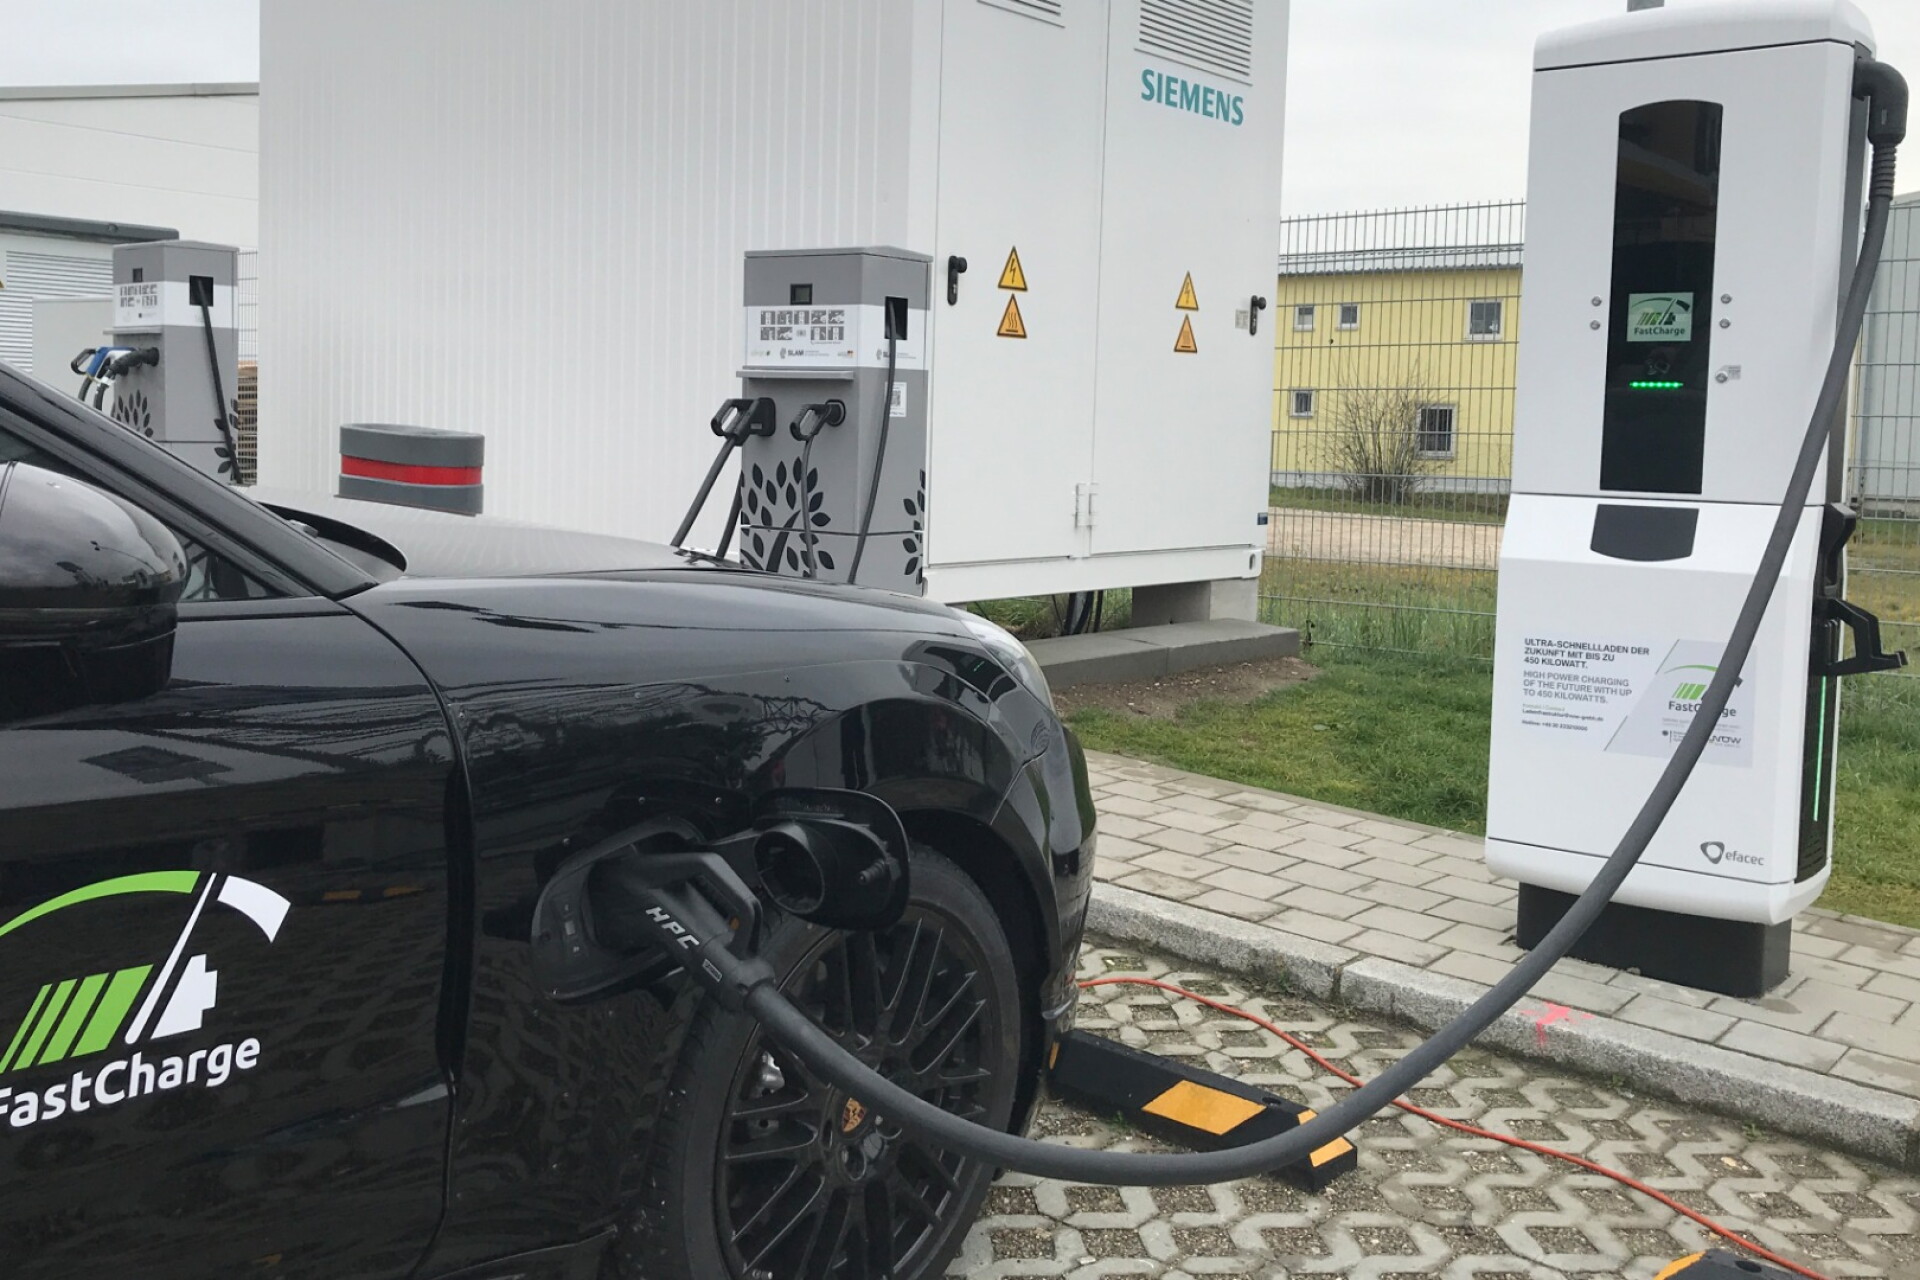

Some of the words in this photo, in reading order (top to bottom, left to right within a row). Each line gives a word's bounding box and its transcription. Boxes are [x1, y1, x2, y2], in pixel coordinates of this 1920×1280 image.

[1141, 69, 1244, 126] SIEMENS
[1634, 326, 1686, 336] FastCharge
[1524, 638, 1629, 654] ULTRA-SCHNELLLADEN
[1630, 646, 1650, 655] DER
[1524, 647, 1565, 658] ZUKUNFT
[1567, 651, 1583, 659] MIT
[1585, 652, 1601, 661] BIS
[1602, 653, 1615, 662] ZU
[1523, 657, 1540, 665] 450
[1541, 658, 1588, 669] KILOWATT.
[1523, 671, 1546, 679] HIGH
[1547, 673, 1580, 682] POWER
[1581, 676, 1629, 686] CHARGING
[1523, 679, 1536, 687] OF
[1537, 680, 1555, 690] THE
[1556, 682, 1593, 693] FUTURE
[1593, 685, 1618, 696] WITH
[1619, 688, 1633, 697] UP
[1523, 688, 1536, 697] TO
[1537, 689, 1553, 698] 450
[1554, 691, 1609, 704] KILOWATTS.
[1668, 701, 1736, 717] FastCge
[1725, 850, 1765, 866] efacec
[645, 906, 700, 949] HPC
